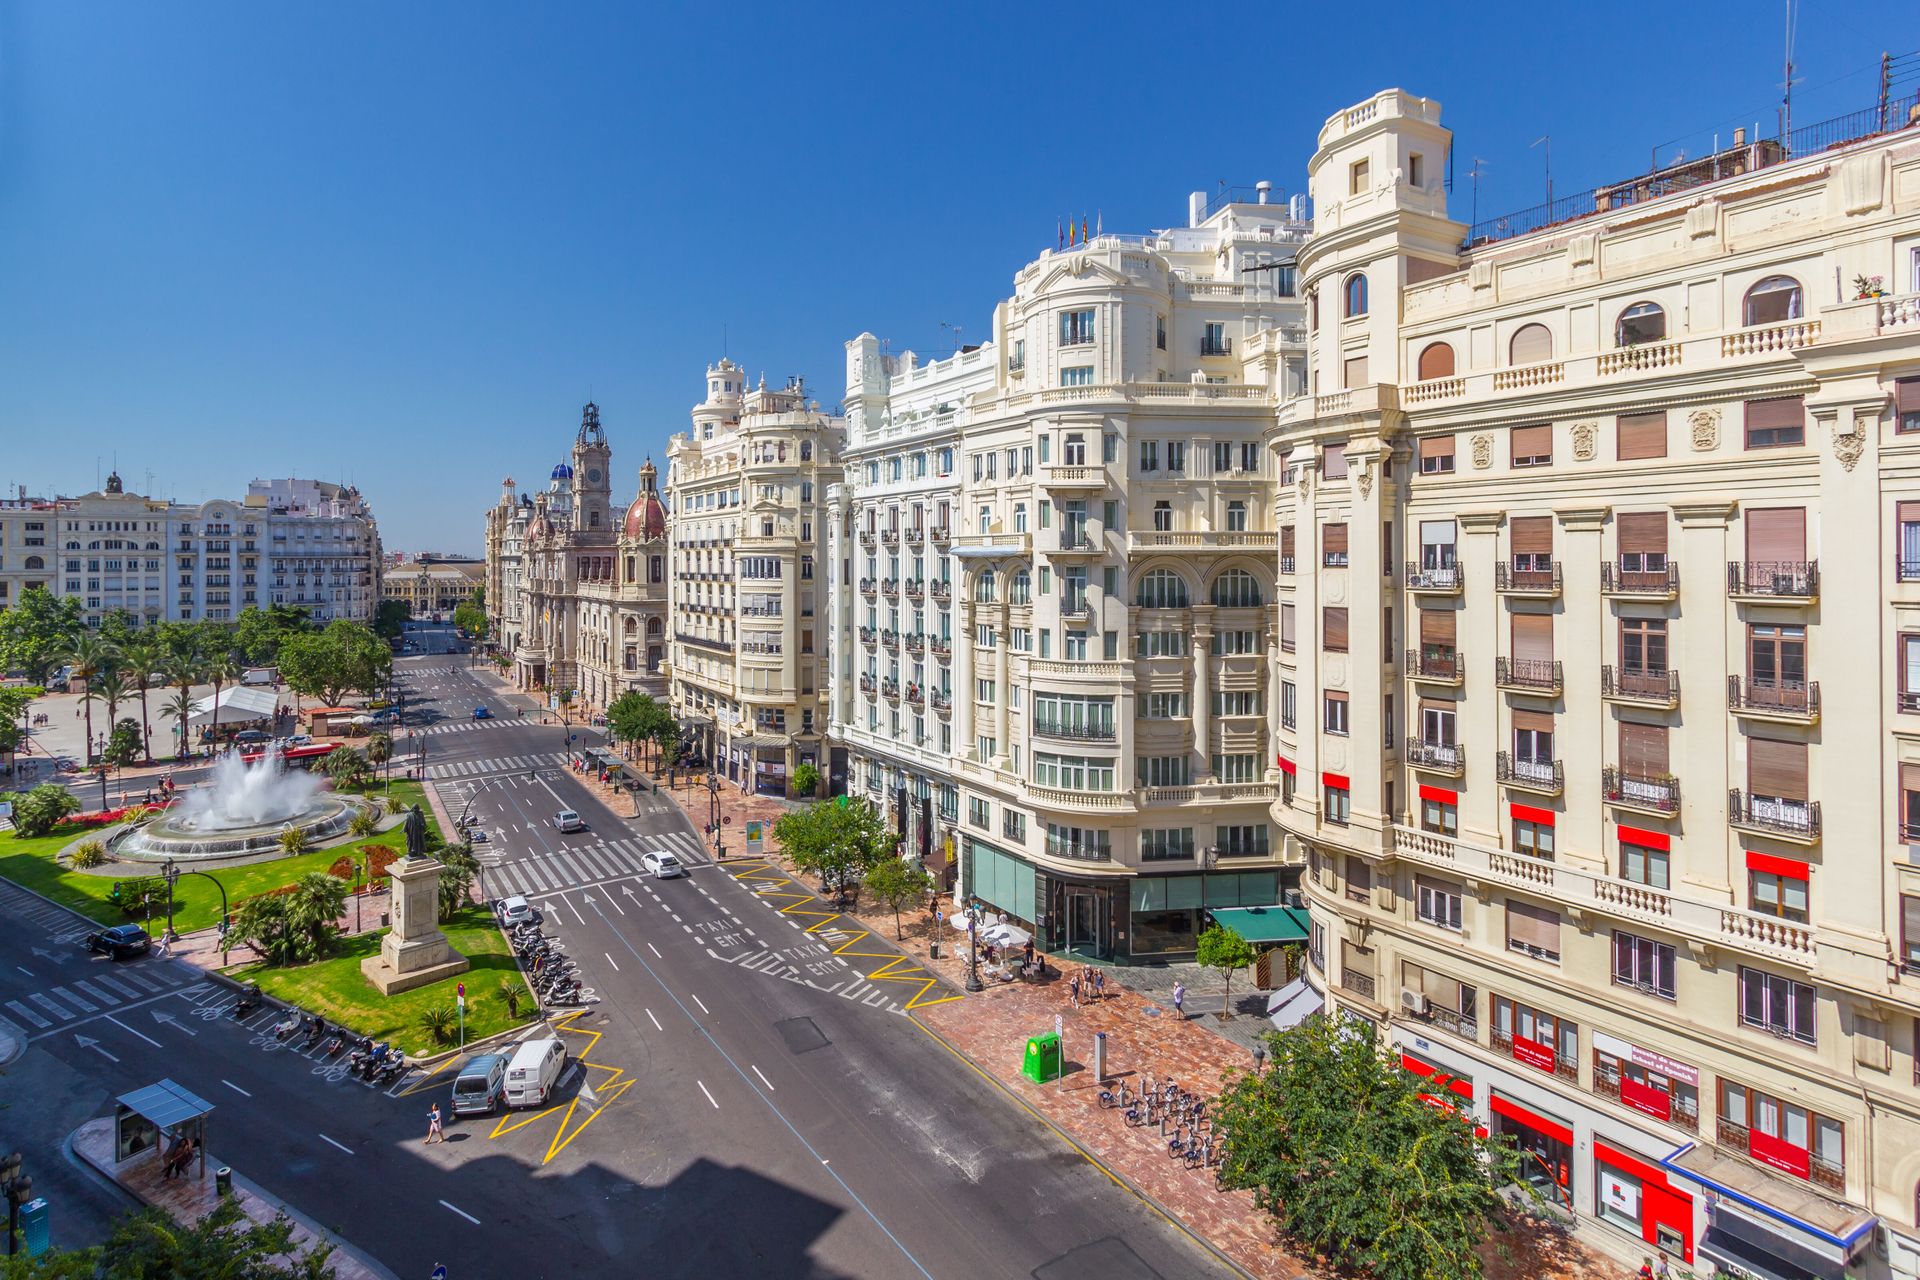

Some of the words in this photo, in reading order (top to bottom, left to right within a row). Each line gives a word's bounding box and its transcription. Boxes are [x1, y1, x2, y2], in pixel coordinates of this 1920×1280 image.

[695, 920, 733, 934] TAXI
[714, 933, 747, 947] EMT
[782, 944, 823, 960] TAXI
[805, 960, 841, 976] EMT
[1632, 1045, 1658, 1060] Escuela
[1658, 1056, 1668, 1064] de
[1669, 1061, 1698, 1075] español
[1632, 1054, 1655, 1067] School
[1655, 1063, 1664, 1071] of
[1664, 1066, 1693, 1082] Spanish
